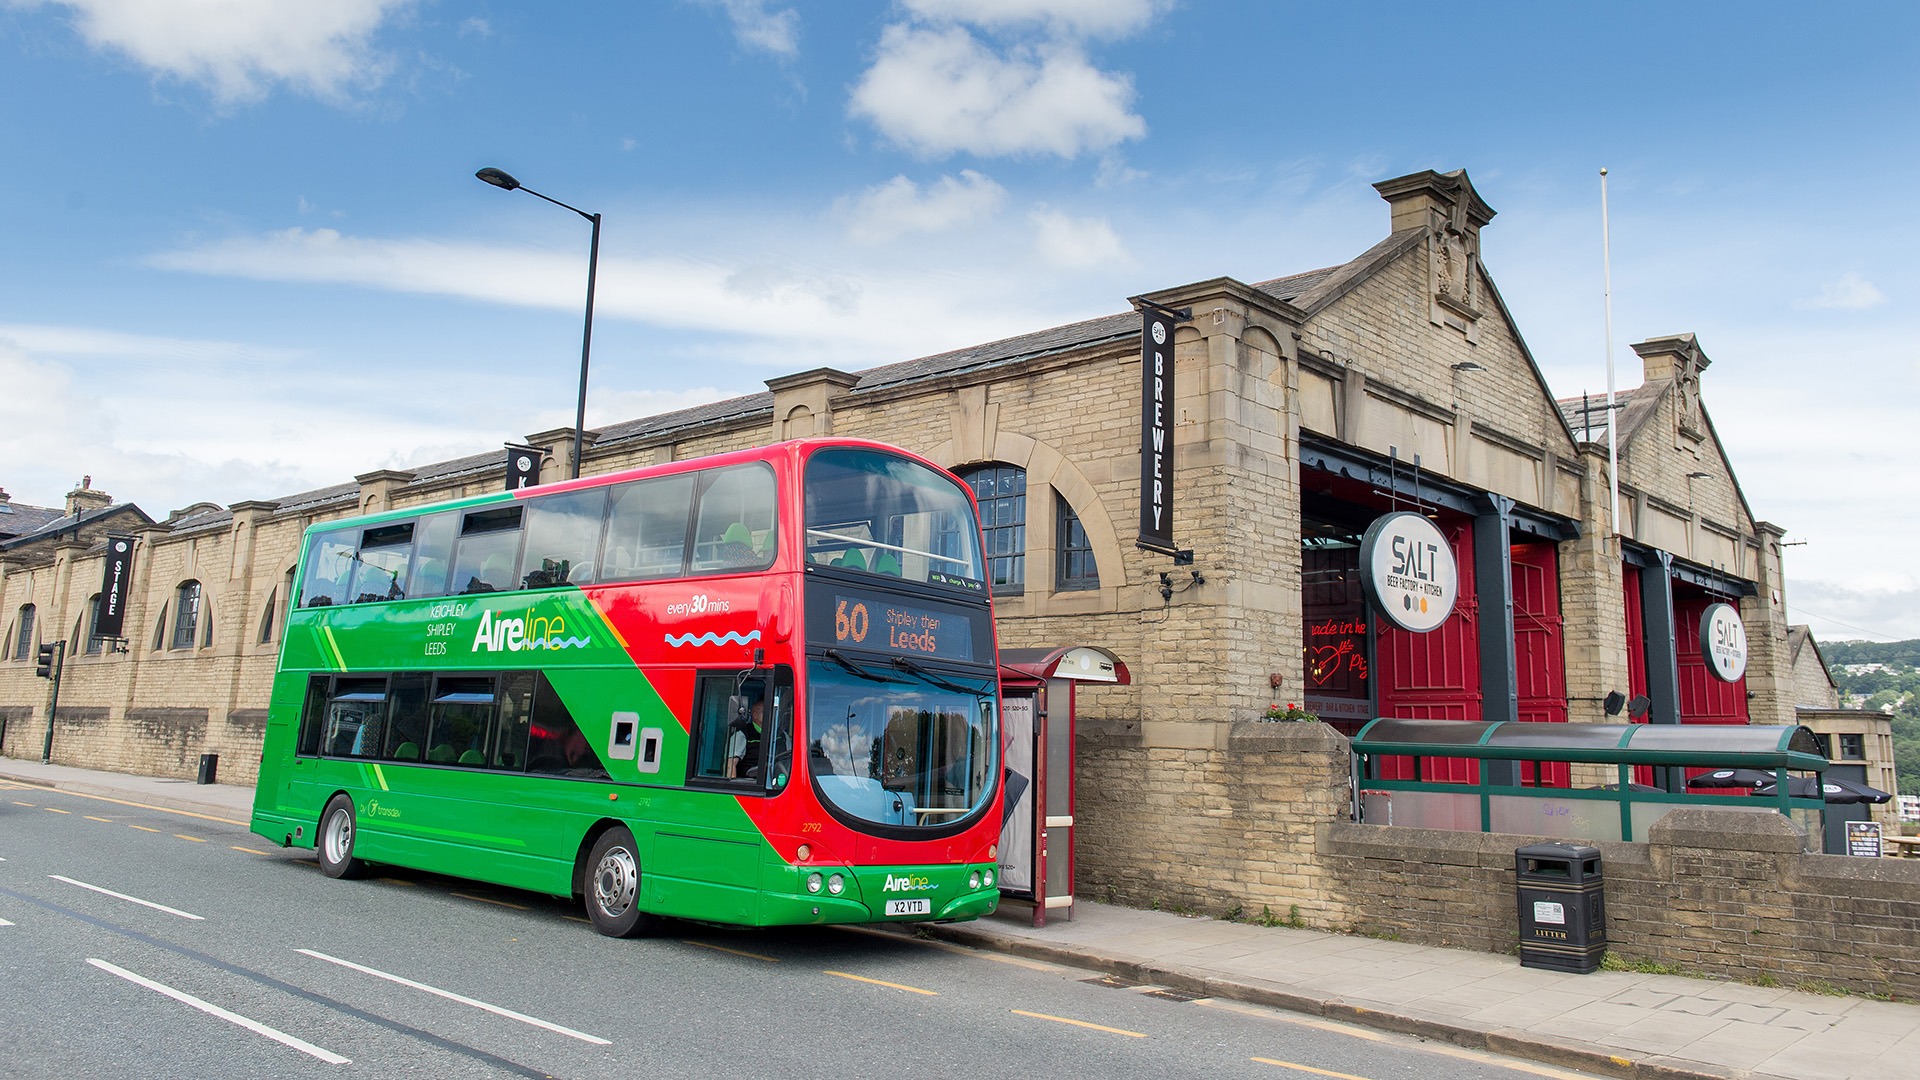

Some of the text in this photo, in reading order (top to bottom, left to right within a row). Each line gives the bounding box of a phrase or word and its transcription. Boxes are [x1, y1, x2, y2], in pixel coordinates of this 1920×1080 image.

[1152, 351, 1165, 531] BREWERY
[1392, 535, 1438, 582] SALT
[108, 560, 122, 615] STAGE
[1387, 575, 1399, 589] BEER
[1399, 577, 1419, 592] FACTORY
[1424, 583, 1443, 597] KITCHEN
[430, 603, 467, 618] KEIGHLEY
[667, 594, 730, 617] every 30 mins
[426, 622, 457, 637] SHIPLEY
[471, 607, 565, 652] Aireline
[835, 600, 869, 643] 60
[886, 608, 940, 630] Shipley then
[890, 626, 936, 653] Leeds
[1717, 619, 1738, 649] SALT
[424, 641, 447, 656] LEEDS
[802, 822, 822, 833] 2792
[882, 873, 929, 892] Aireline
[894, 900, 923, 913] X2 VTD
[1535, 929, 1567, 939] LITTER
